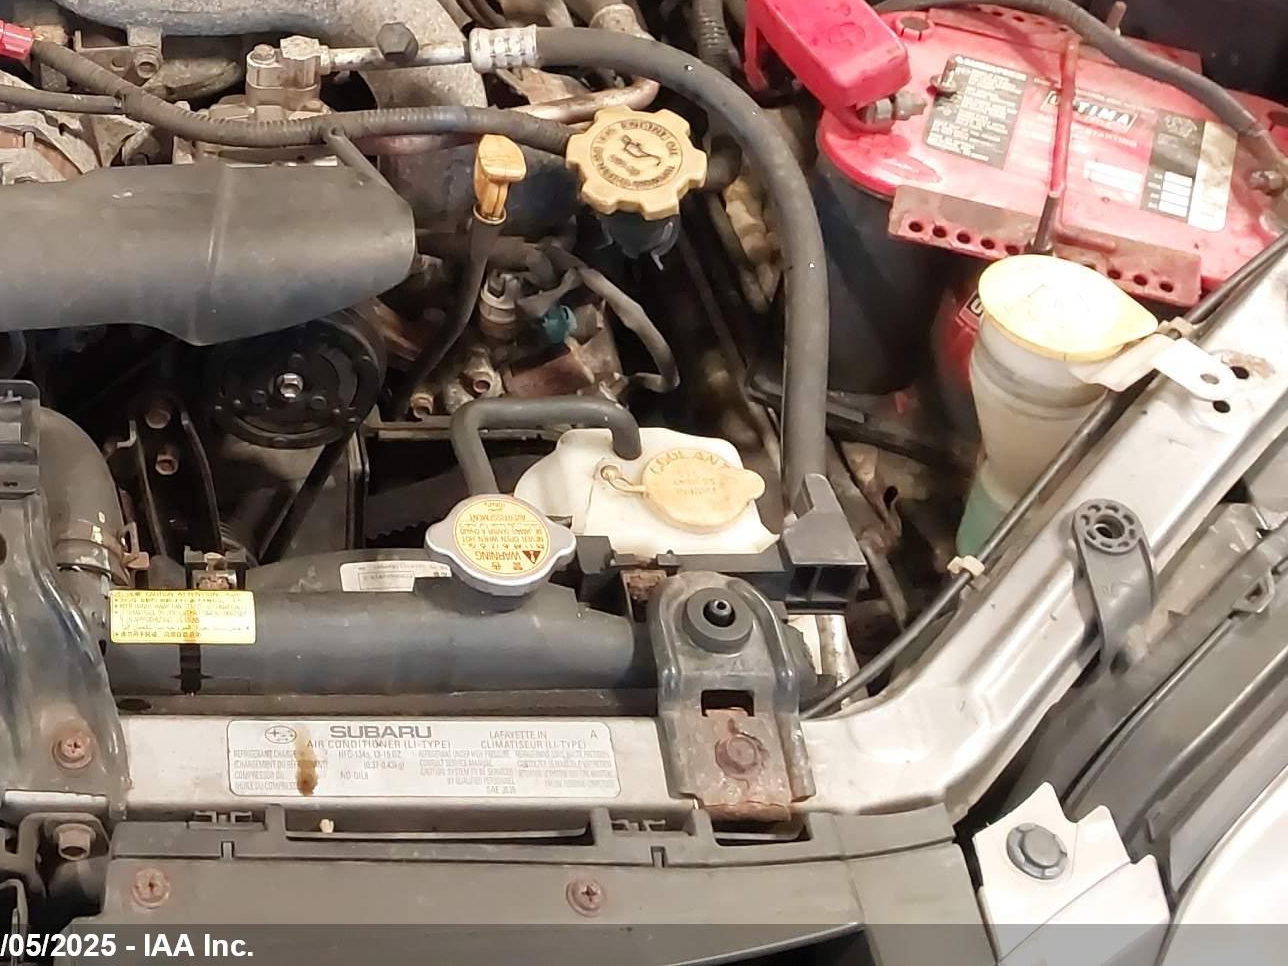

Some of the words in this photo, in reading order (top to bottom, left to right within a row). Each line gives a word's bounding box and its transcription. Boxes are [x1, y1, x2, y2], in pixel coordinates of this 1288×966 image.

[1046, 91, 1132, 126] OTIMA
[474, 550, 522, 561] WARNING
[329, 725, 432, 739] SUBARU
[590, 729, 598, 739] A
[306, 739, 325, 749] AIR
[327, 739, 401, 749] CONDITIONER
[480, 739, 543, 749] CLIMATISEUR
